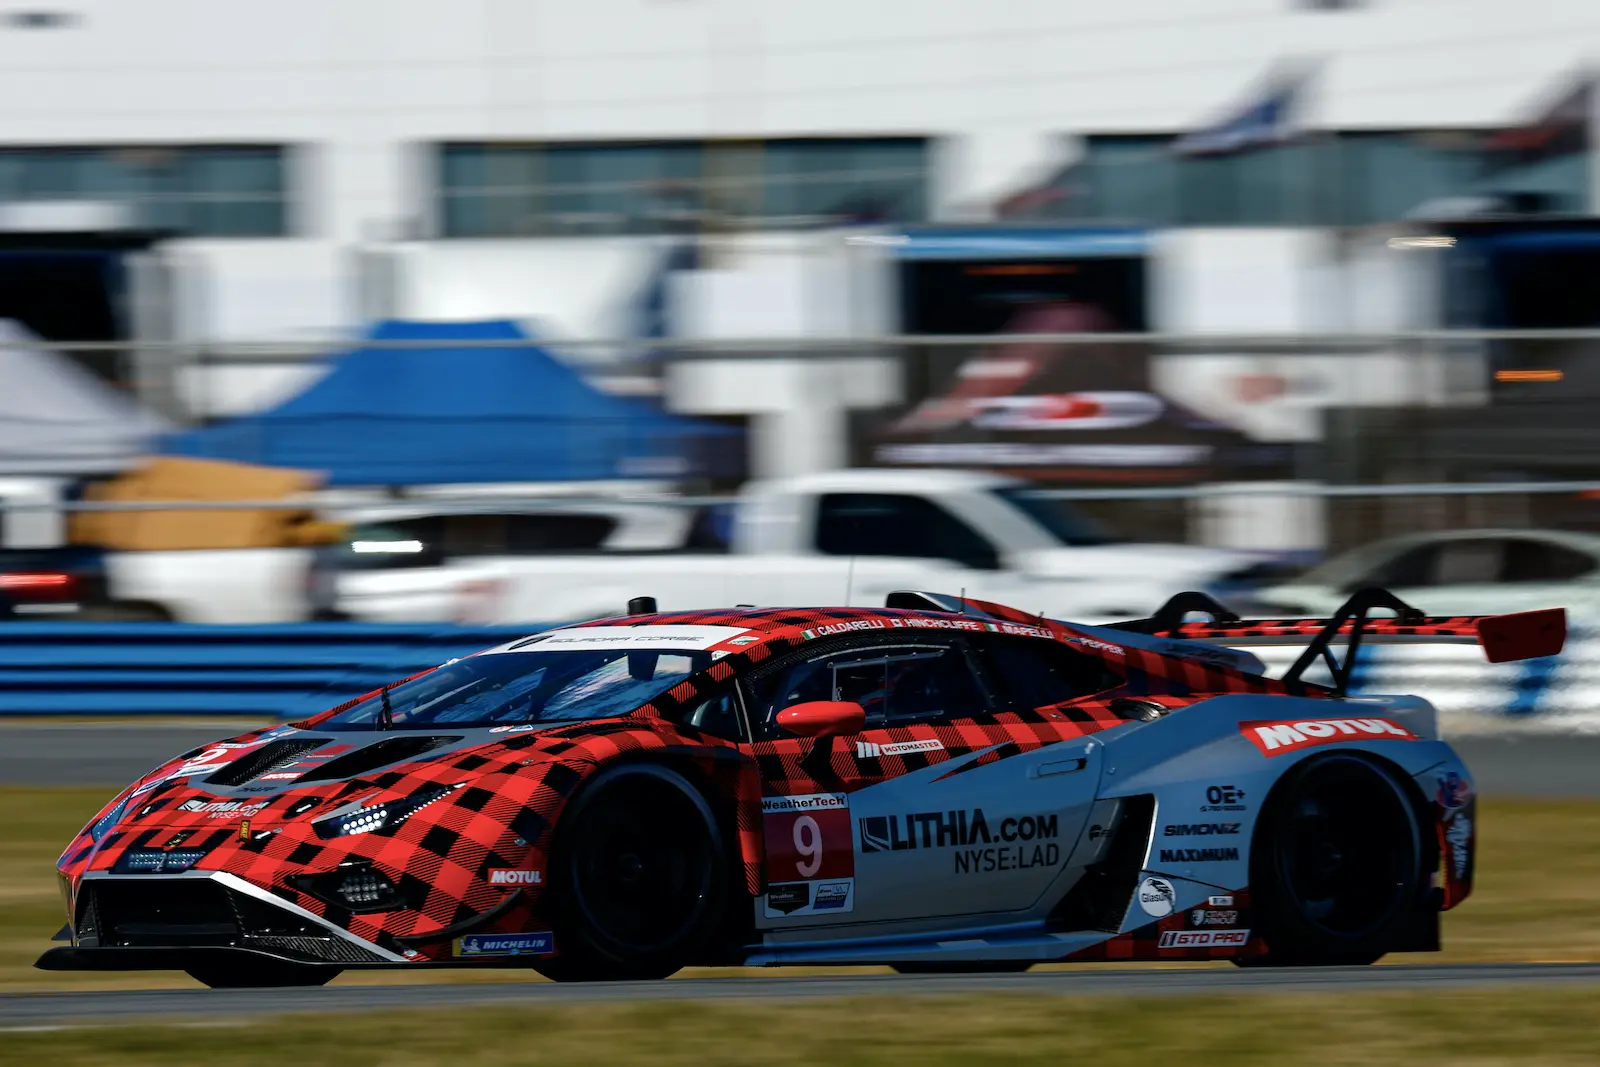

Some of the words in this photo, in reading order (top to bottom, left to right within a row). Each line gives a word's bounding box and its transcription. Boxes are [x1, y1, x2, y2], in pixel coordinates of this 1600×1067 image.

[818, 619, 884, 636] CALDARELLI
[1002, 624, 1055, 639] MAPELLI
[1254, 718, 1408, 750] MOTUL
[884, 740, 941, 754] MOTOMASTER
[762, 796, 846, 810] WeatherTech
[888, 808, 1059, 850] LITHIA.COM
[793, 815, 823, 878] 9
[955, 843, 1060, 874] NYSE:LAD
[1160, 848, 1240, 863] MAXIMUM
[490, 870, 543, 884] MOTUL
[483, 938, 546, 950] MICHELIN
[1213, 932, 1246, 944] PRO
